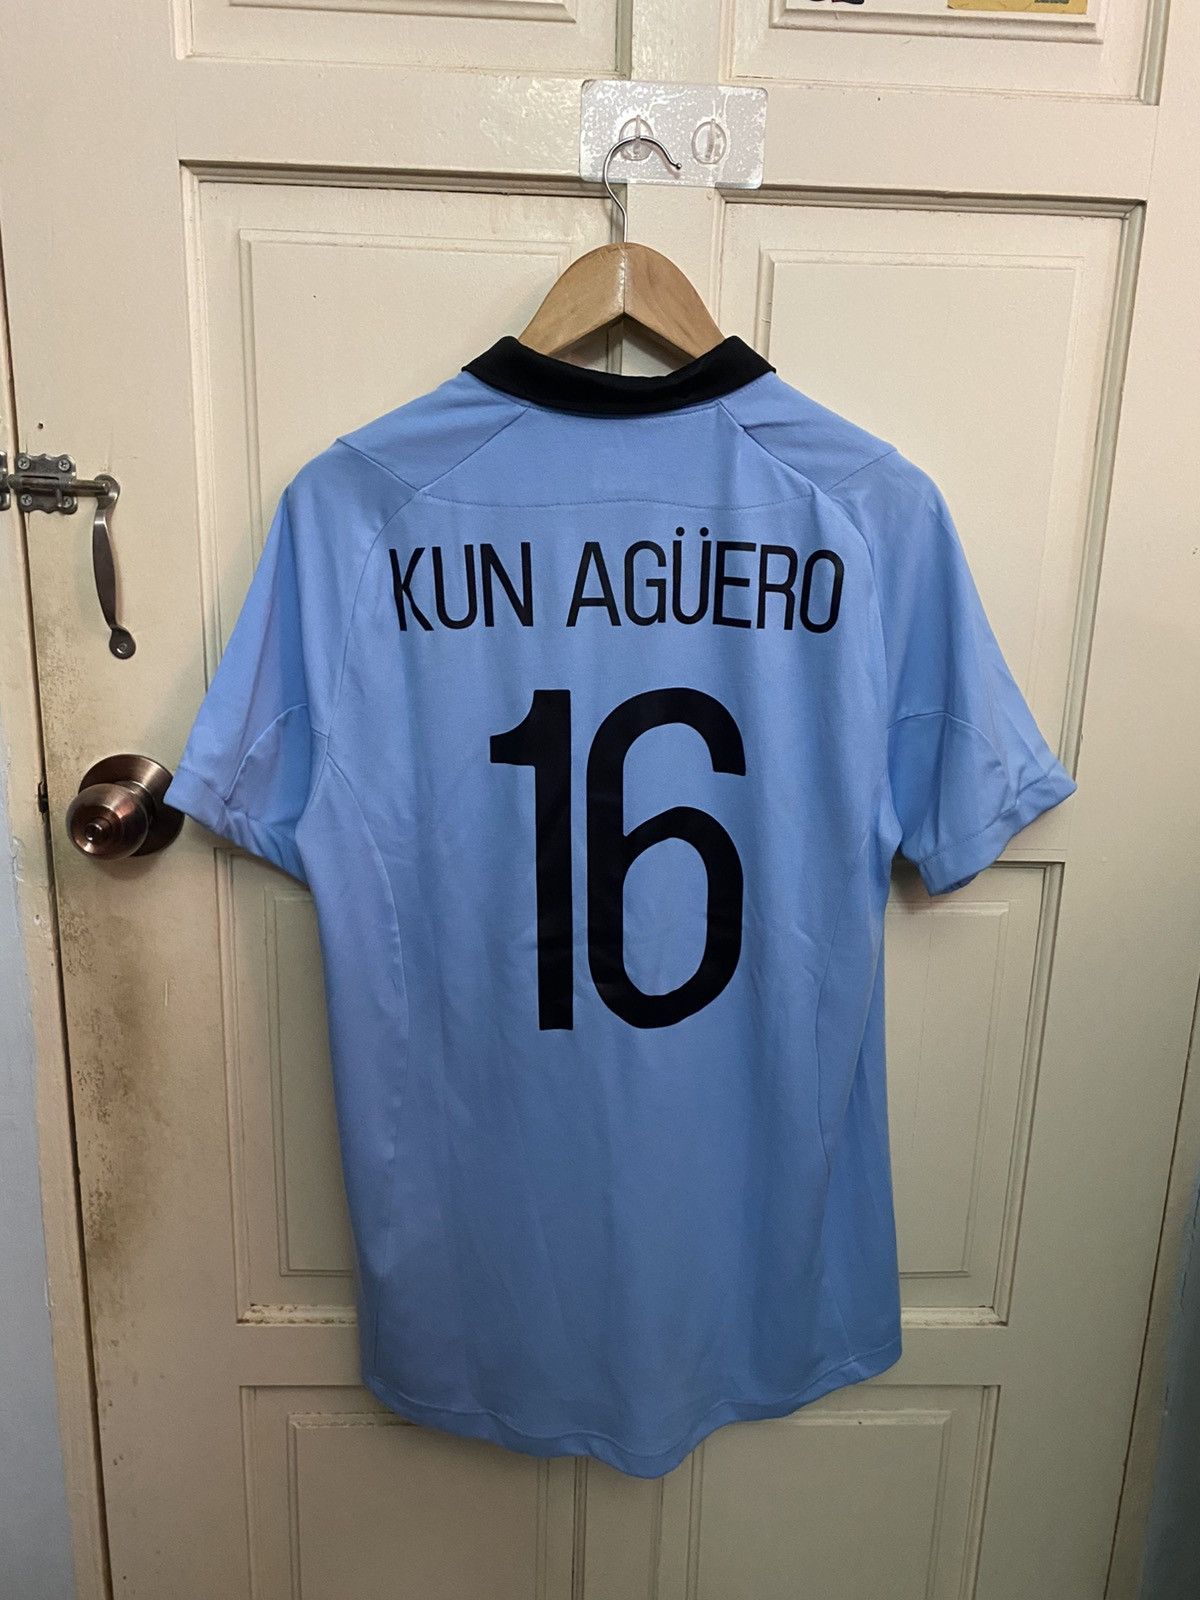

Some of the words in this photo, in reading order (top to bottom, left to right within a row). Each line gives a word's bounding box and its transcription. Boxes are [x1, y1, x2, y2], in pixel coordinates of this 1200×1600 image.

[388, 541, 534, 631] KUN
[565, 526, 845, 634] AGÜERO
[489, 687, 747, 1032] 16
